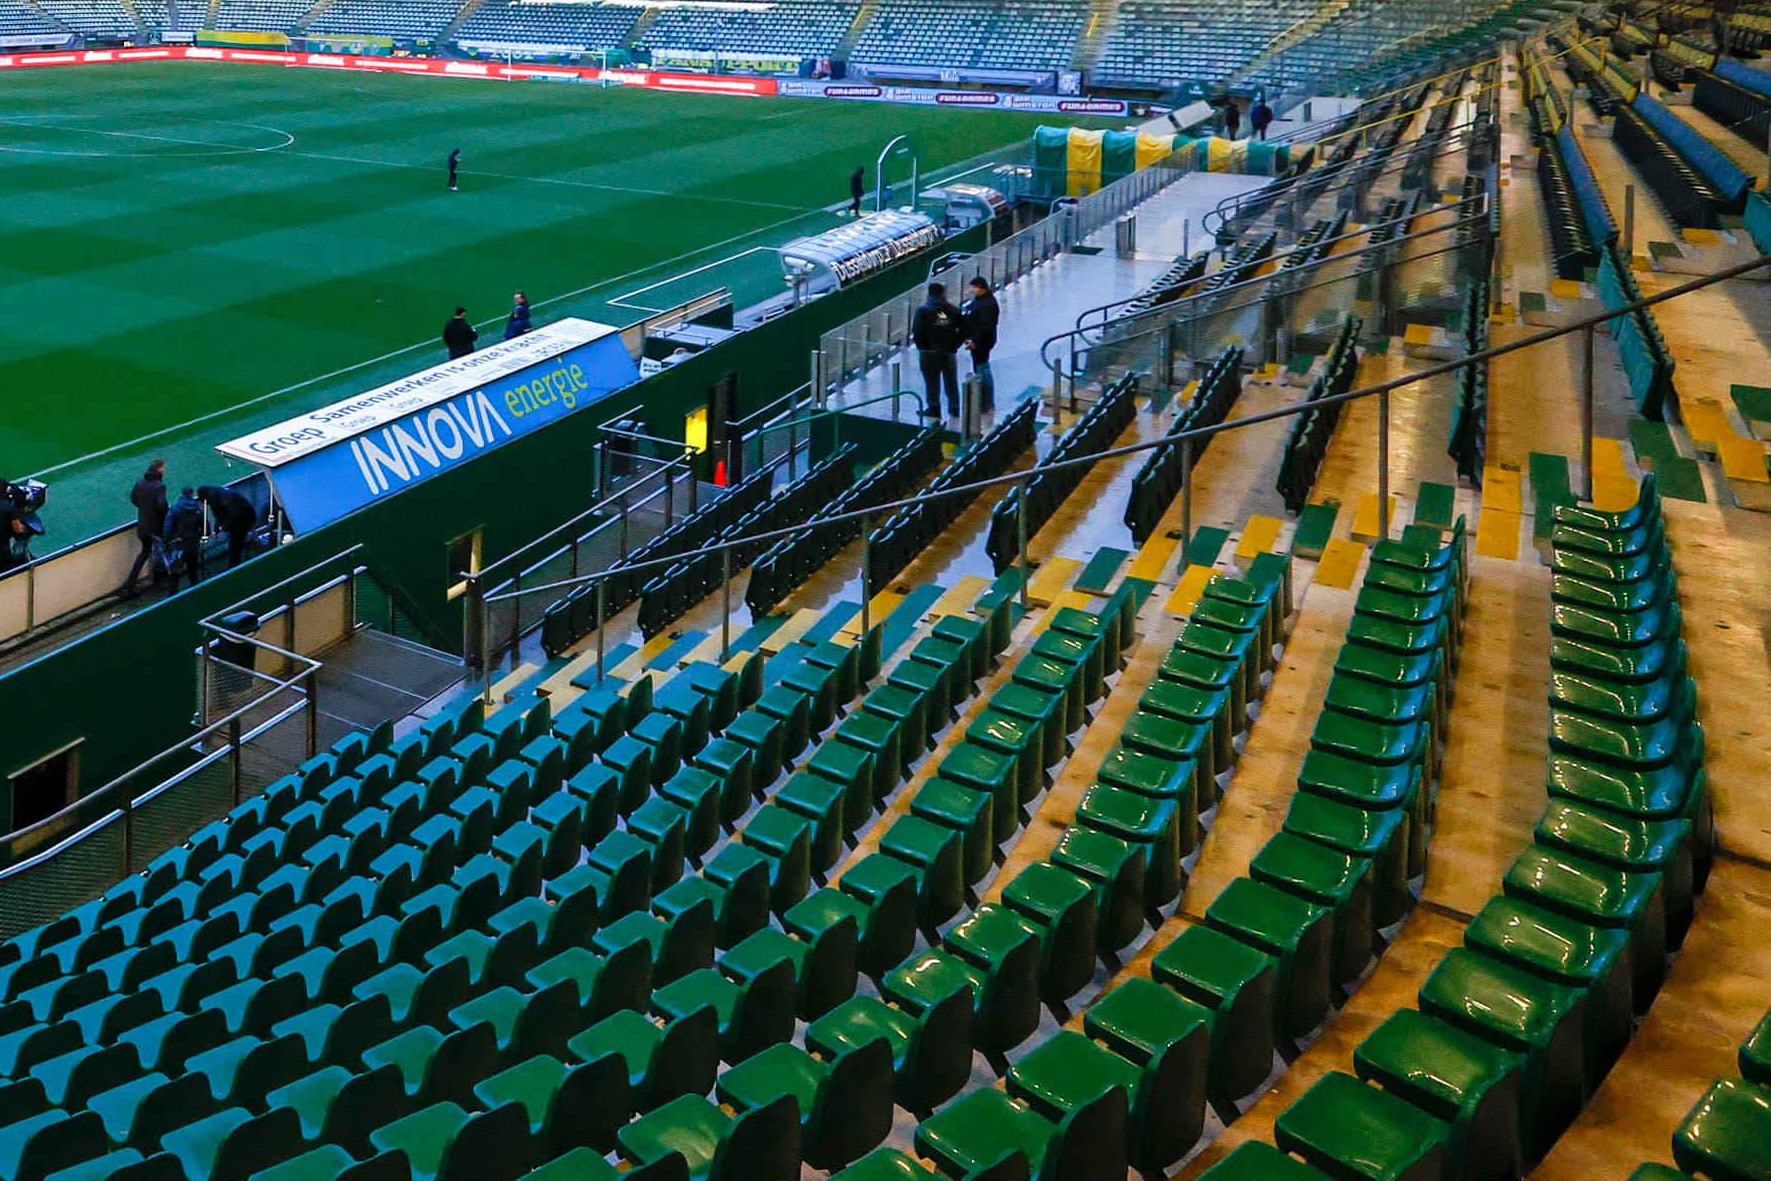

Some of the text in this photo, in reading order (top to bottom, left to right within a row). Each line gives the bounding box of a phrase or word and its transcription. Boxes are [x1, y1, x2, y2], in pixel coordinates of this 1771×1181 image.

[248, 424, 327, 455] Groep
[310, 373, 446, 423] Samenwerken
[463, 351, 504, 368] onze
[501, 333, 552, 353] kracht
[350, 357, 588, 495] INNOVA energie
